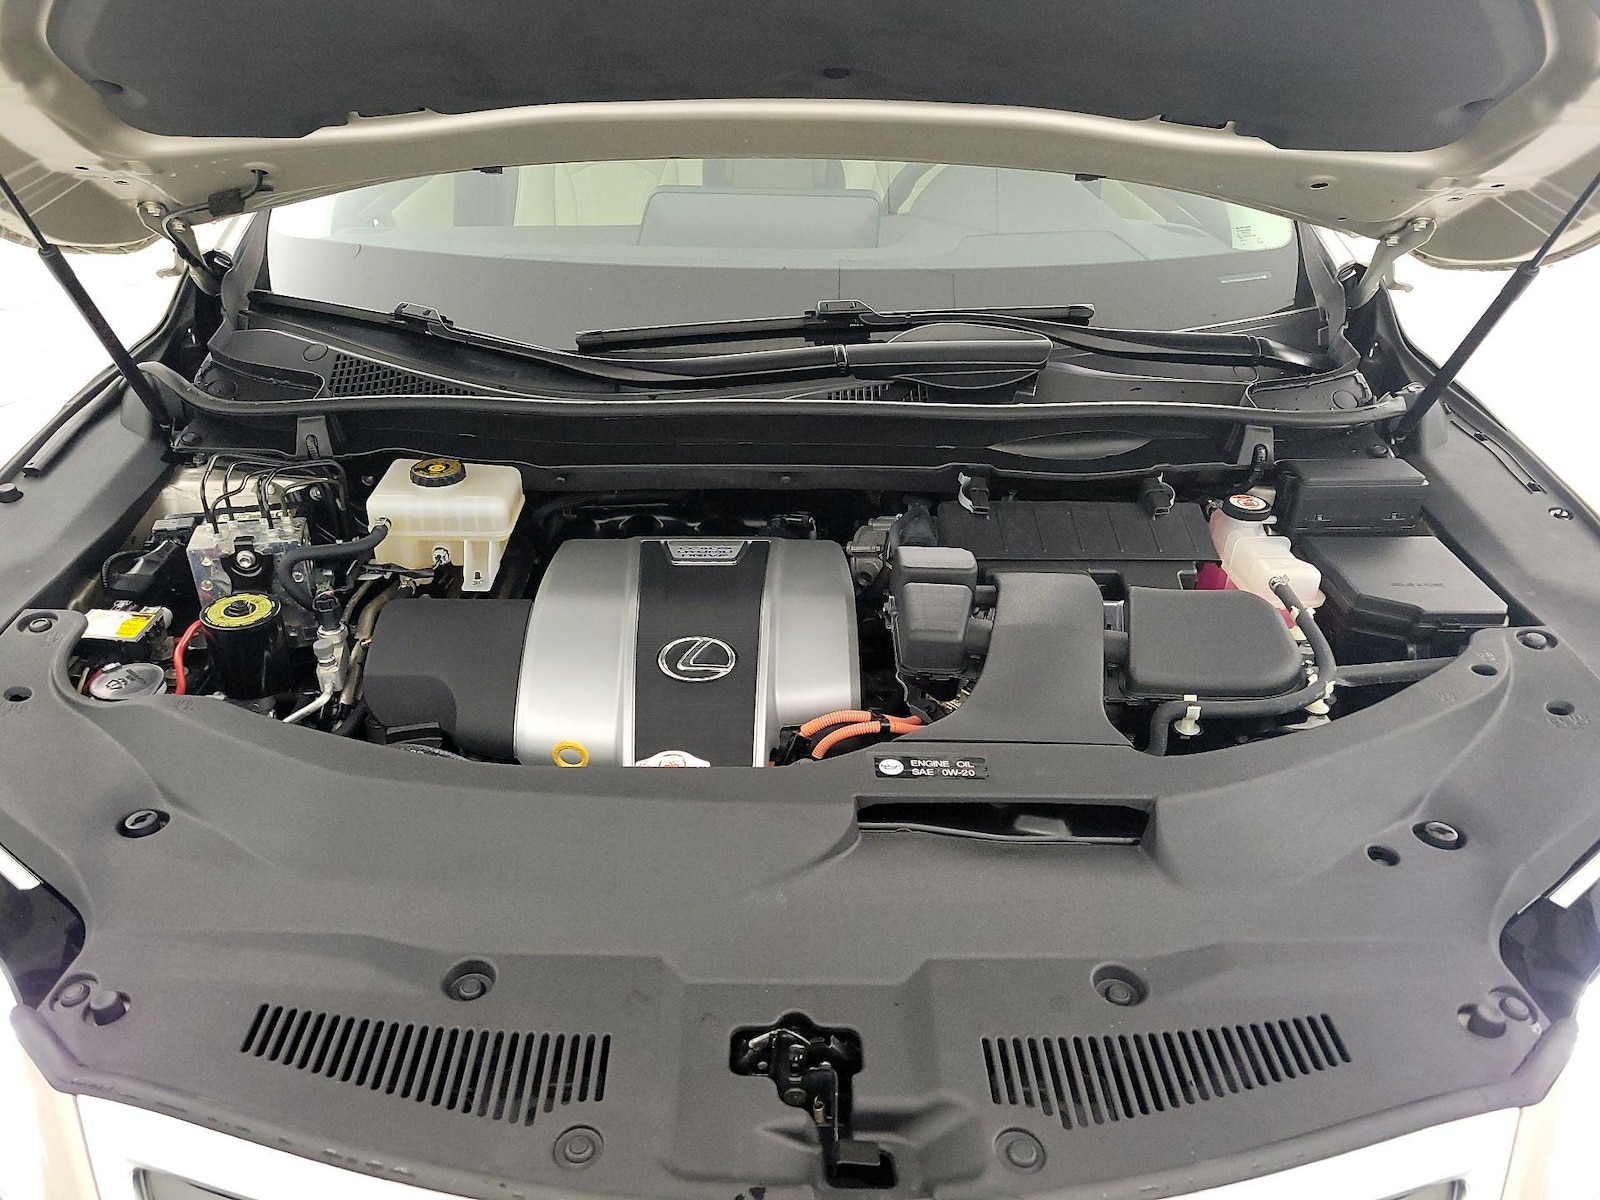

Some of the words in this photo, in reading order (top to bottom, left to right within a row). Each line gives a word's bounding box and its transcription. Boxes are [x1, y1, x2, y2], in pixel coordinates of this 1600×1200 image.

[910, 759, 950, 768] ENGINE
[956, 760, 975, 768] OIL
[911, 768, 935, 776] SAE
[941, 768, 976, 777] 0W-20
